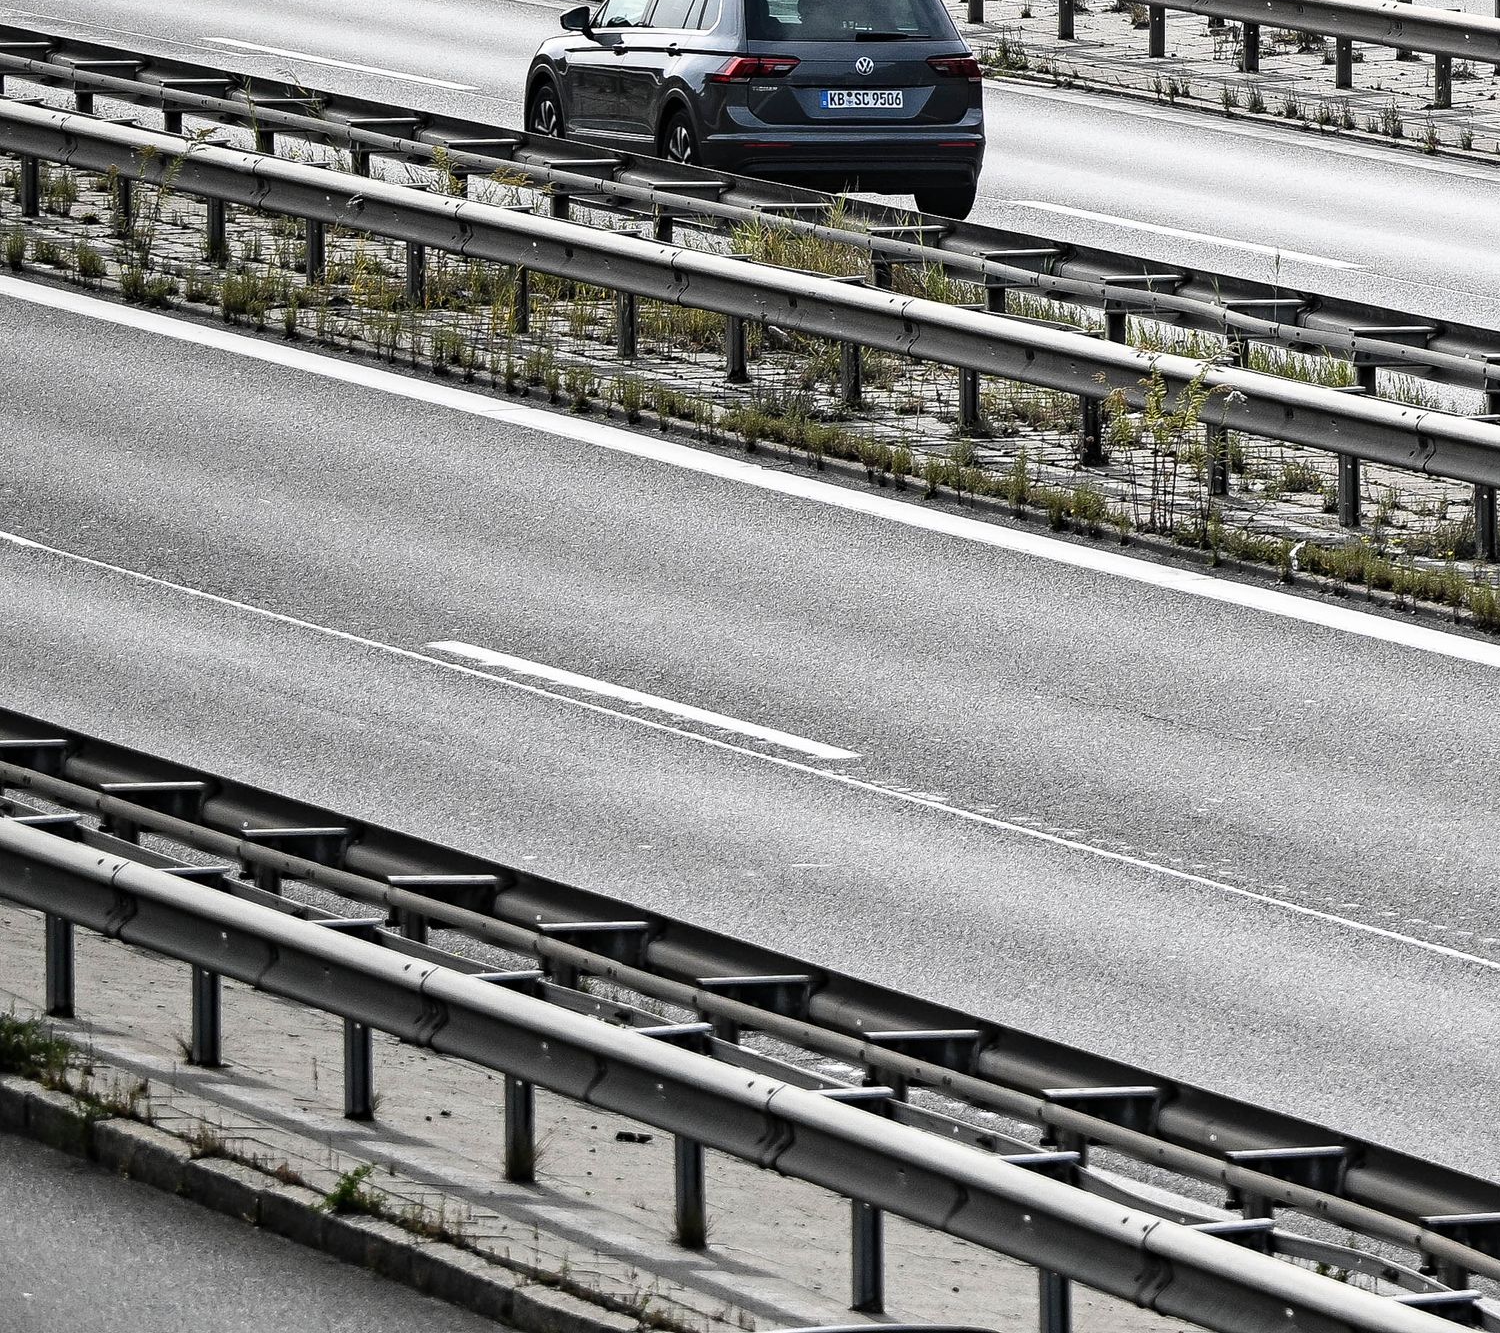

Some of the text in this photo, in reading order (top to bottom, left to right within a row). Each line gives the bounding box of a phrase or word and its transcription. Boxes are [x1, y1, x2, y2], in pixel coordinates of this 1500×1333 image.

[829, 91, 902, 107] KB SC 9506
